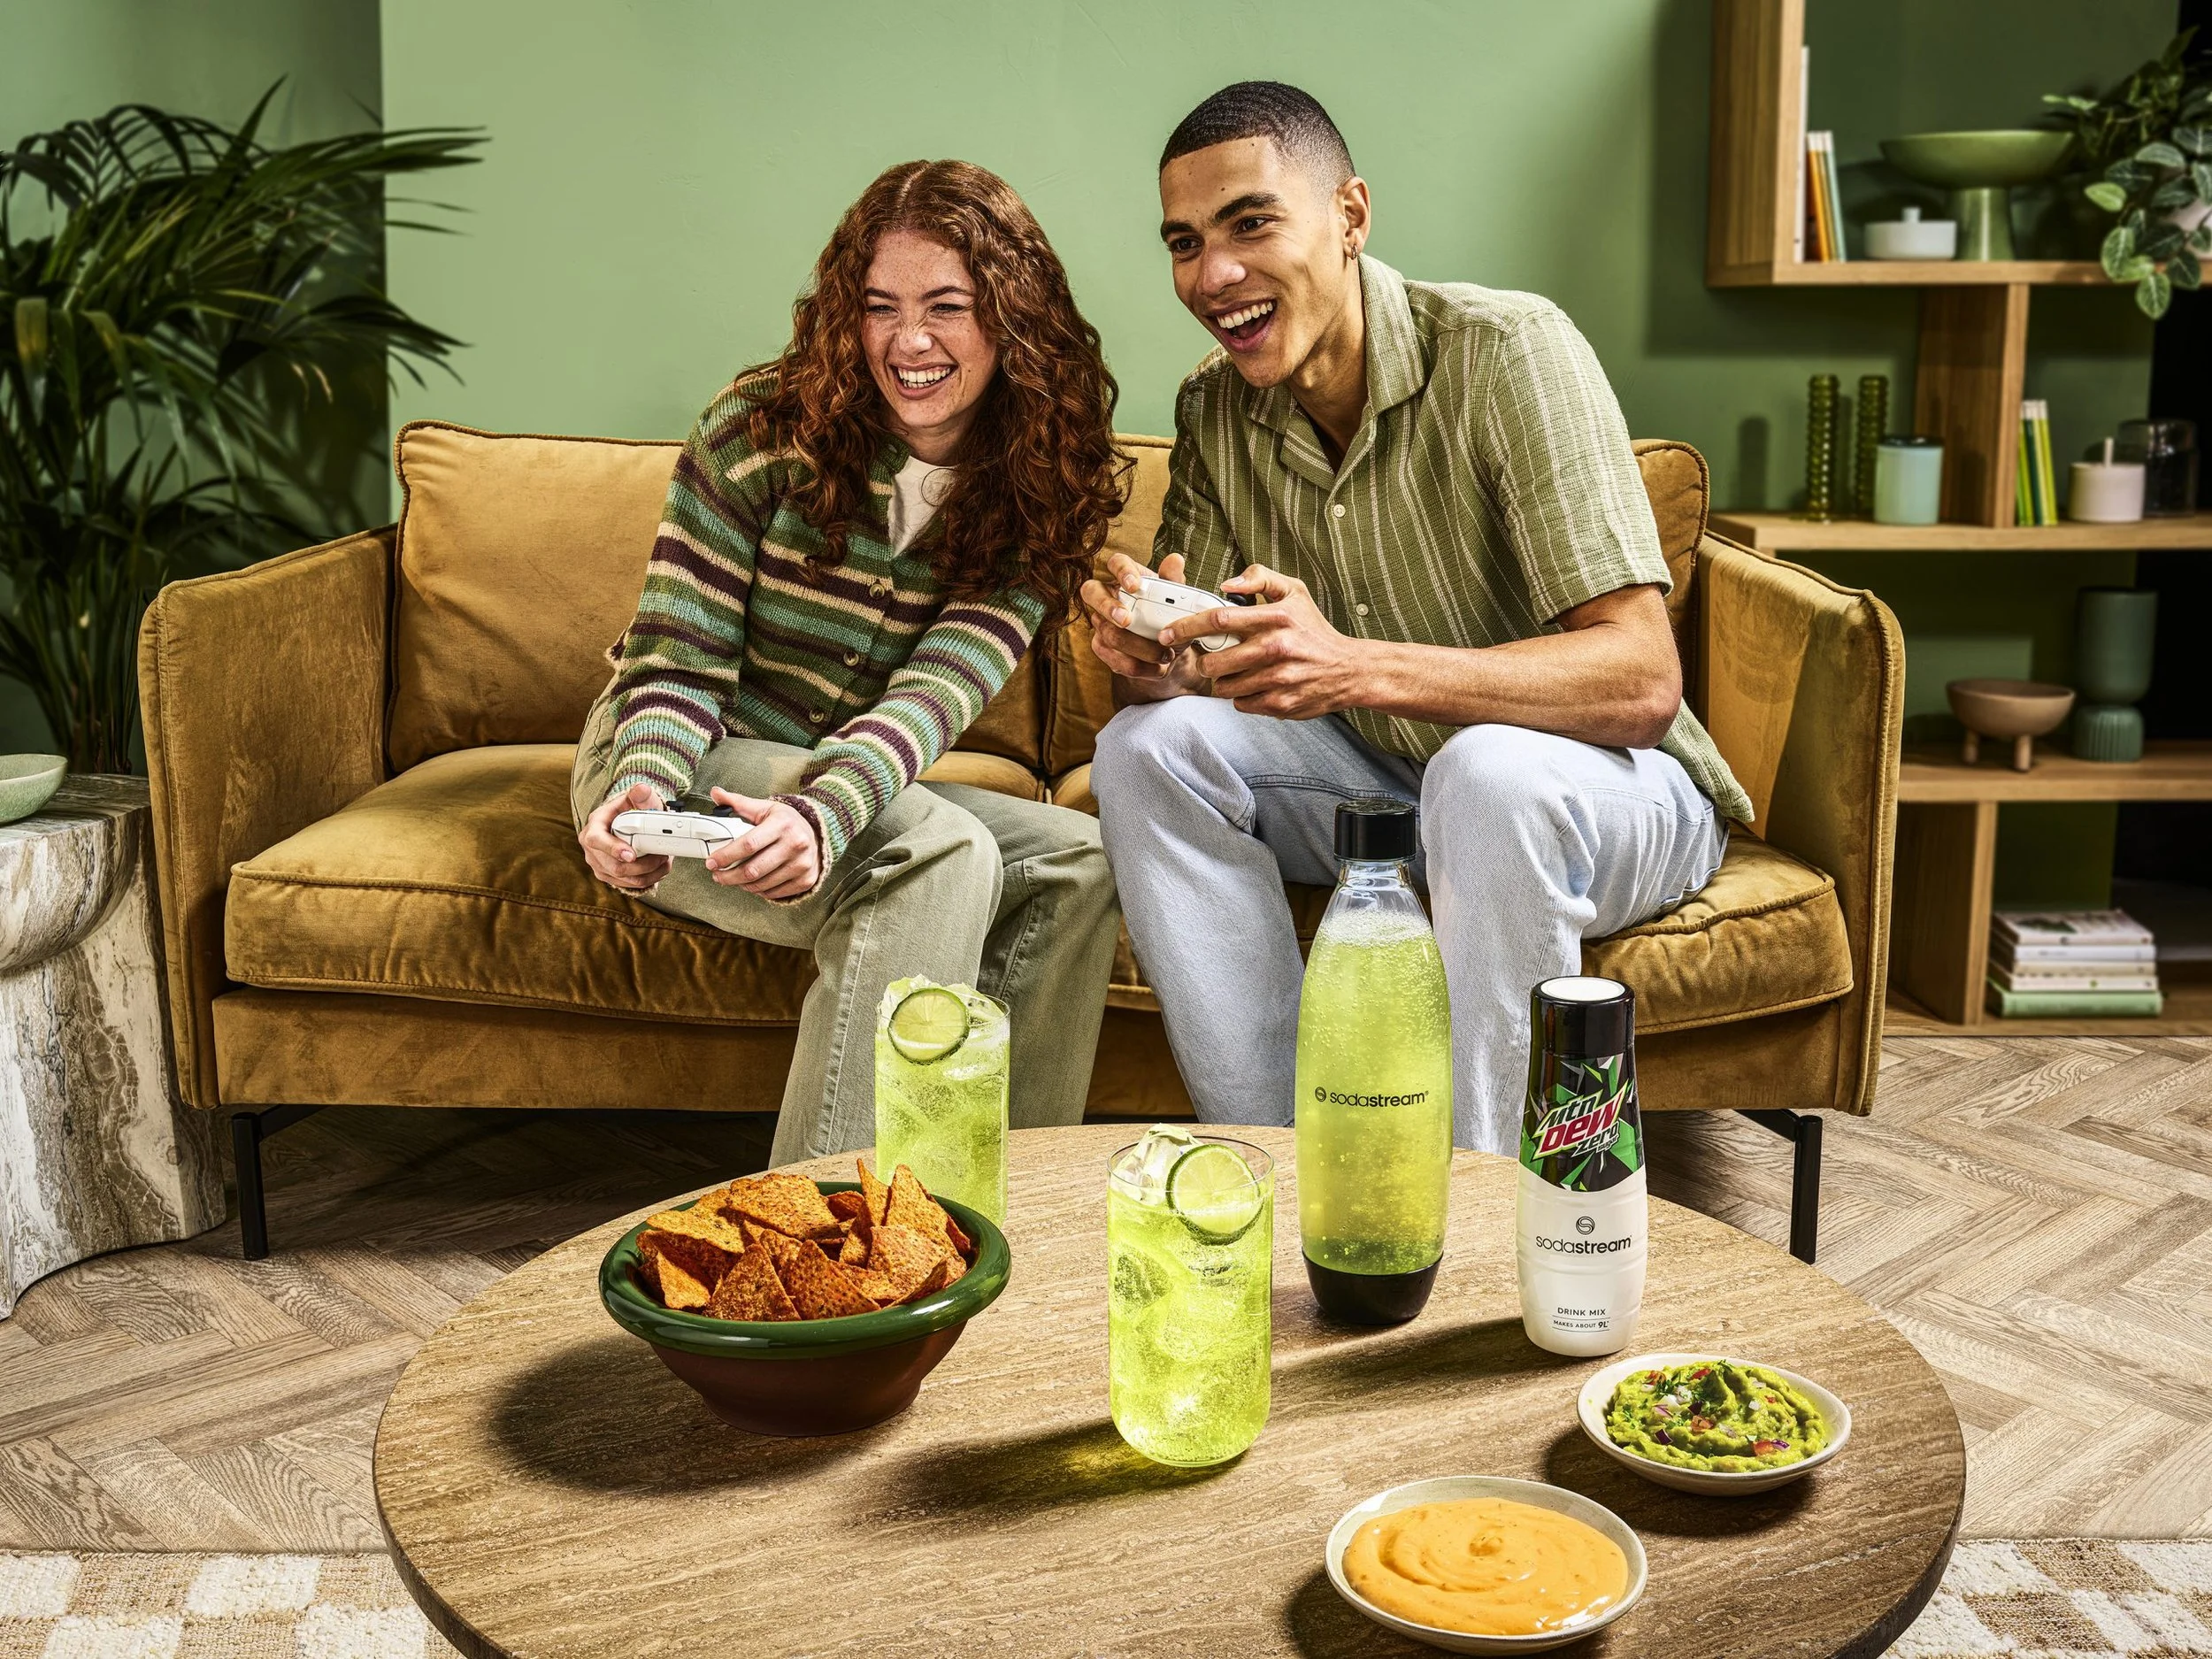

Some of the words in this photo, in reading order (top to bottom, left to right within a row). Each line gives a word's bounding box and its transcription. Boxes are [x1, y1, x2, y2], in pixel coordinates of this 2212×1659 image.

[1330, 1092, 1425, 1107] sodastream
[1540, 1095, 1597, 1132] Mtn
[1536, 1235, 1631, 1254] sodastream
[1557, 1307, 1586, 1316] DRINK
